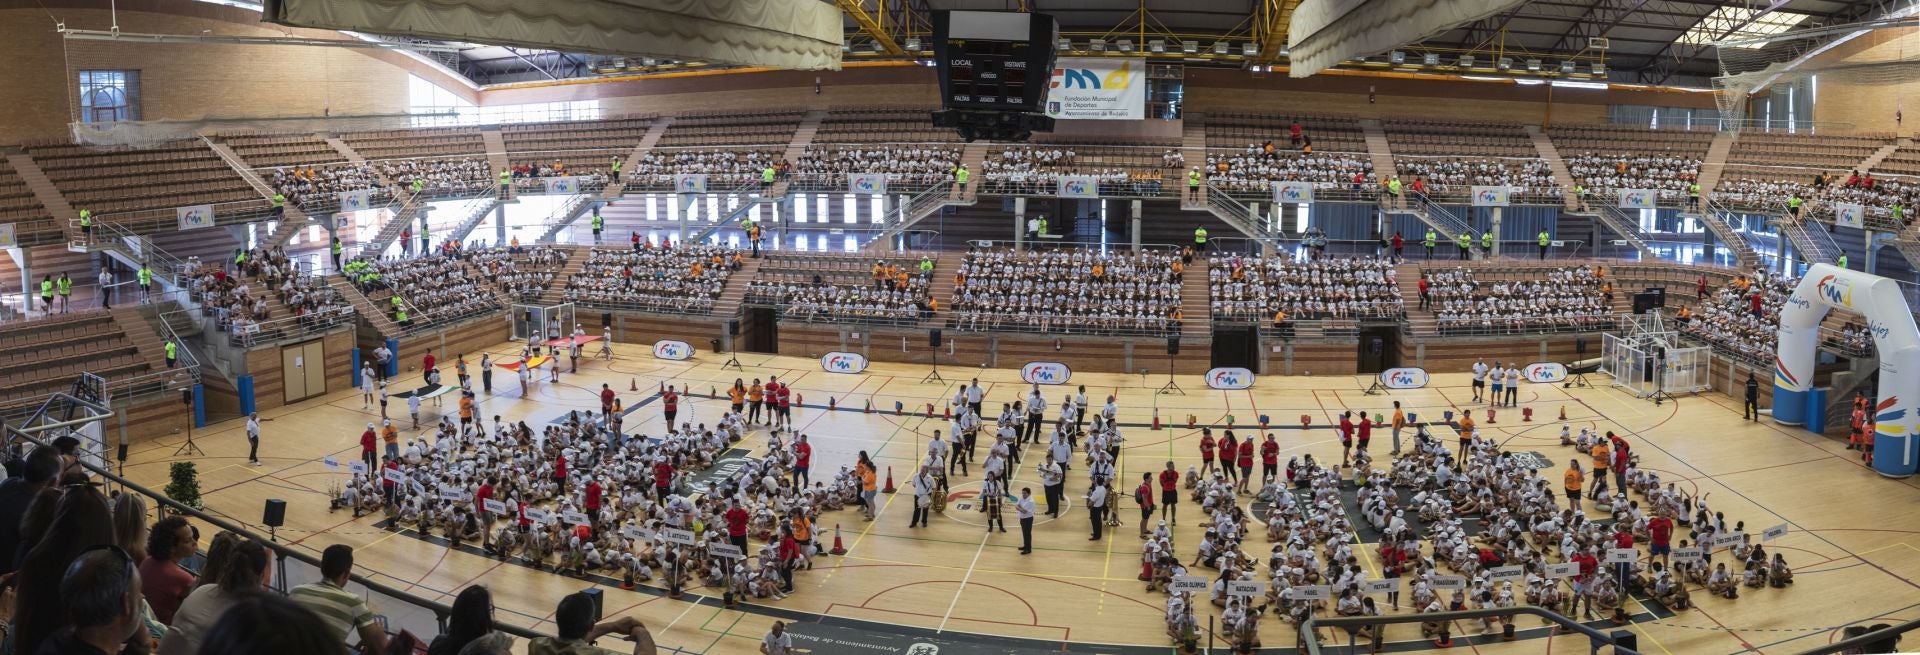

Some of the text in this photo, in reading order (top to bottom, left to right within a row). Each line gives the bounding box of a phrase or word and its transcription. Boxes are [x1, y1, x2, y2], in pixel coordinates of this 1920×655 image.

[951, 59, 974, 67] LOCAL
[1091, 95, 1117, 103] Municipal
[789, 632, 820, 643] Badajo
[836, 639, 901, 653] Ayuntamiento
